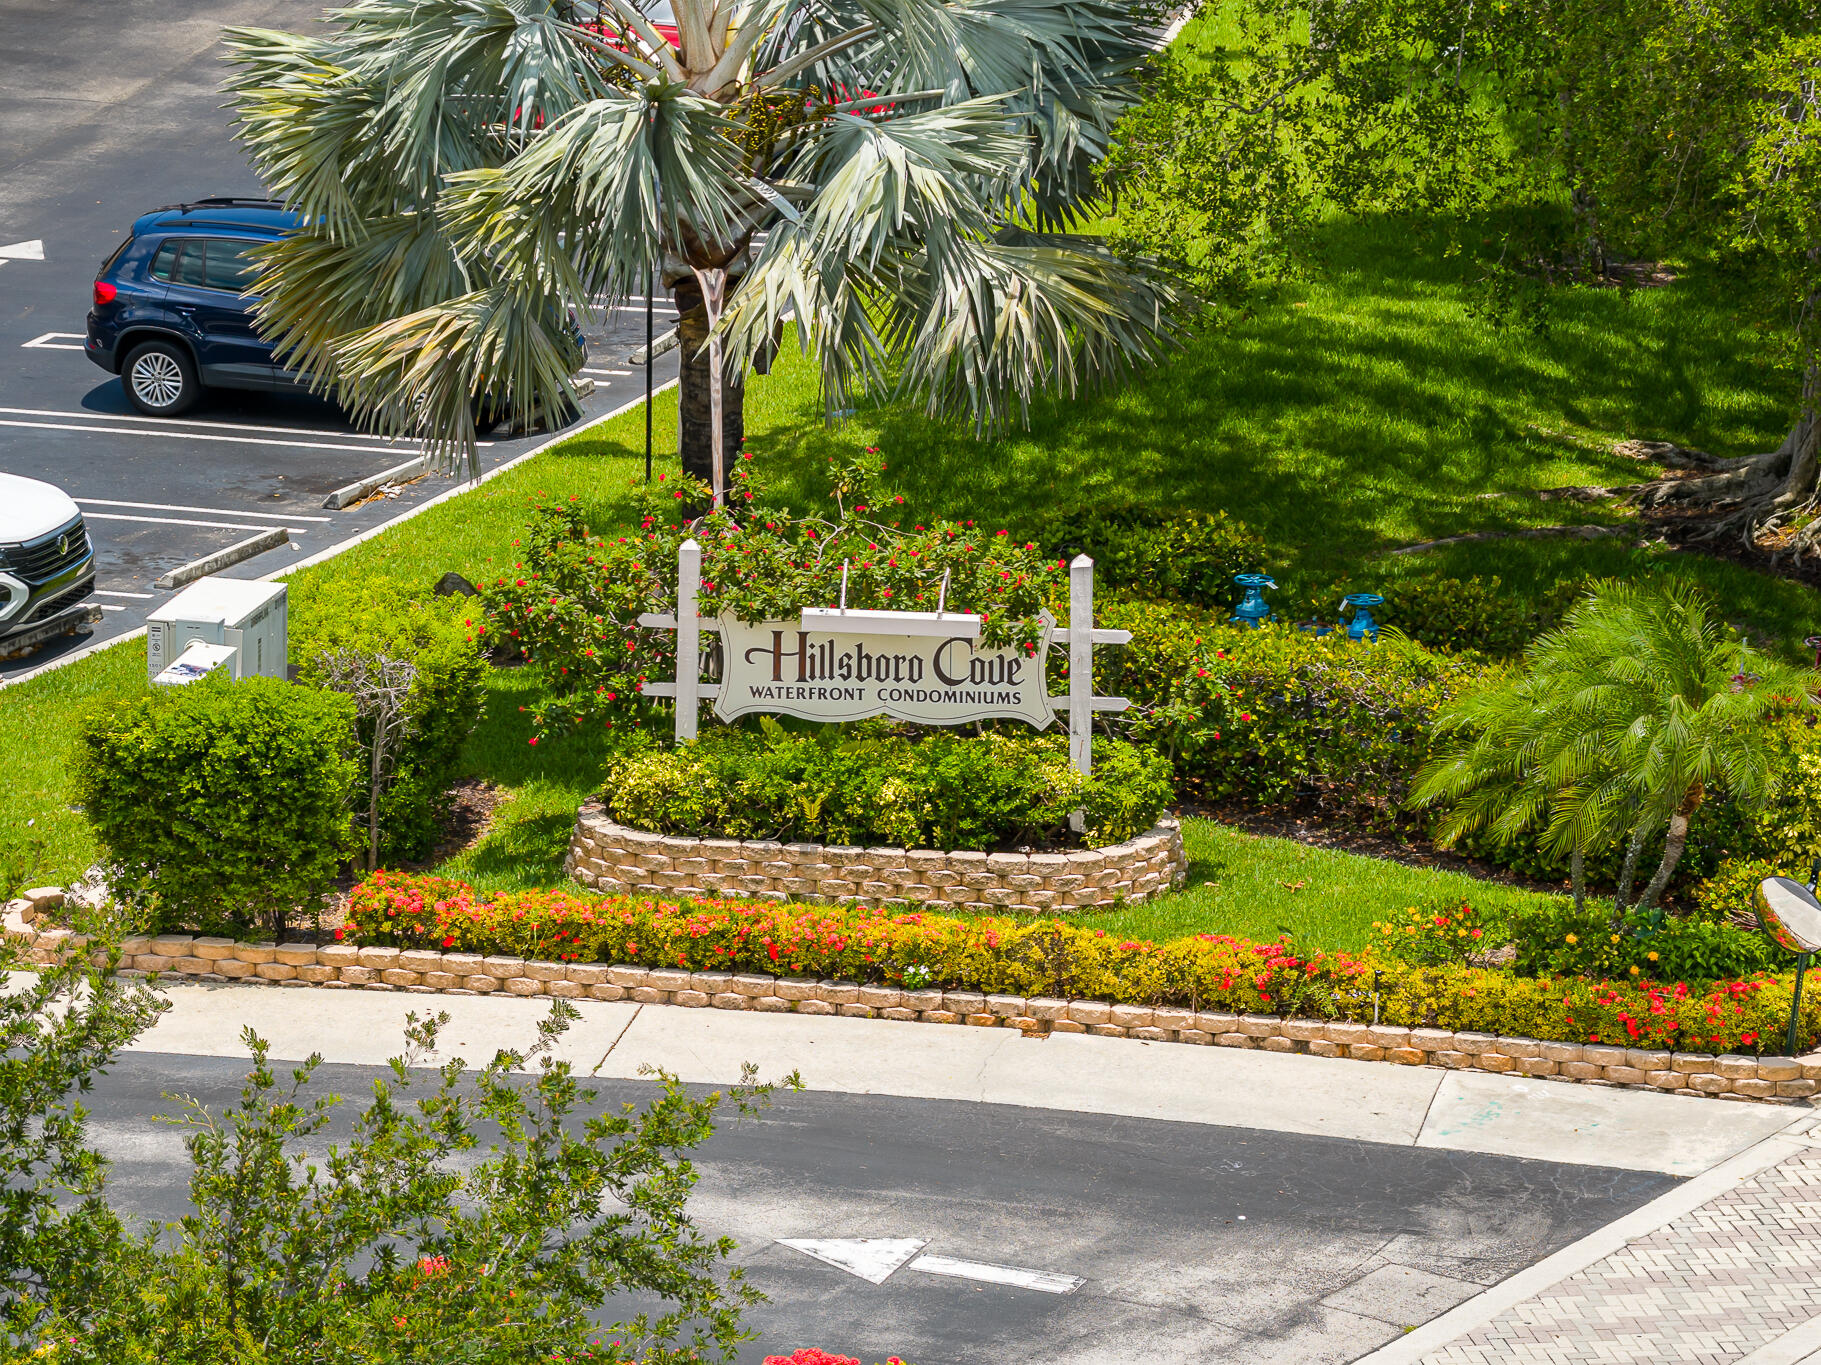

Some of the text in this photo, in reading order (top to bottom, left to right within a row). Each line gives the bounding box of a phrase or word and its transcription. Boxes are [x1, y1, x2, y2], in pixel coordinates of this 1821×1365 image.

[744, 630, 1026, 687] Hillsboro Cove
[748, 685, 1022, 705] WATERFRONT CONDOMINIUMS
